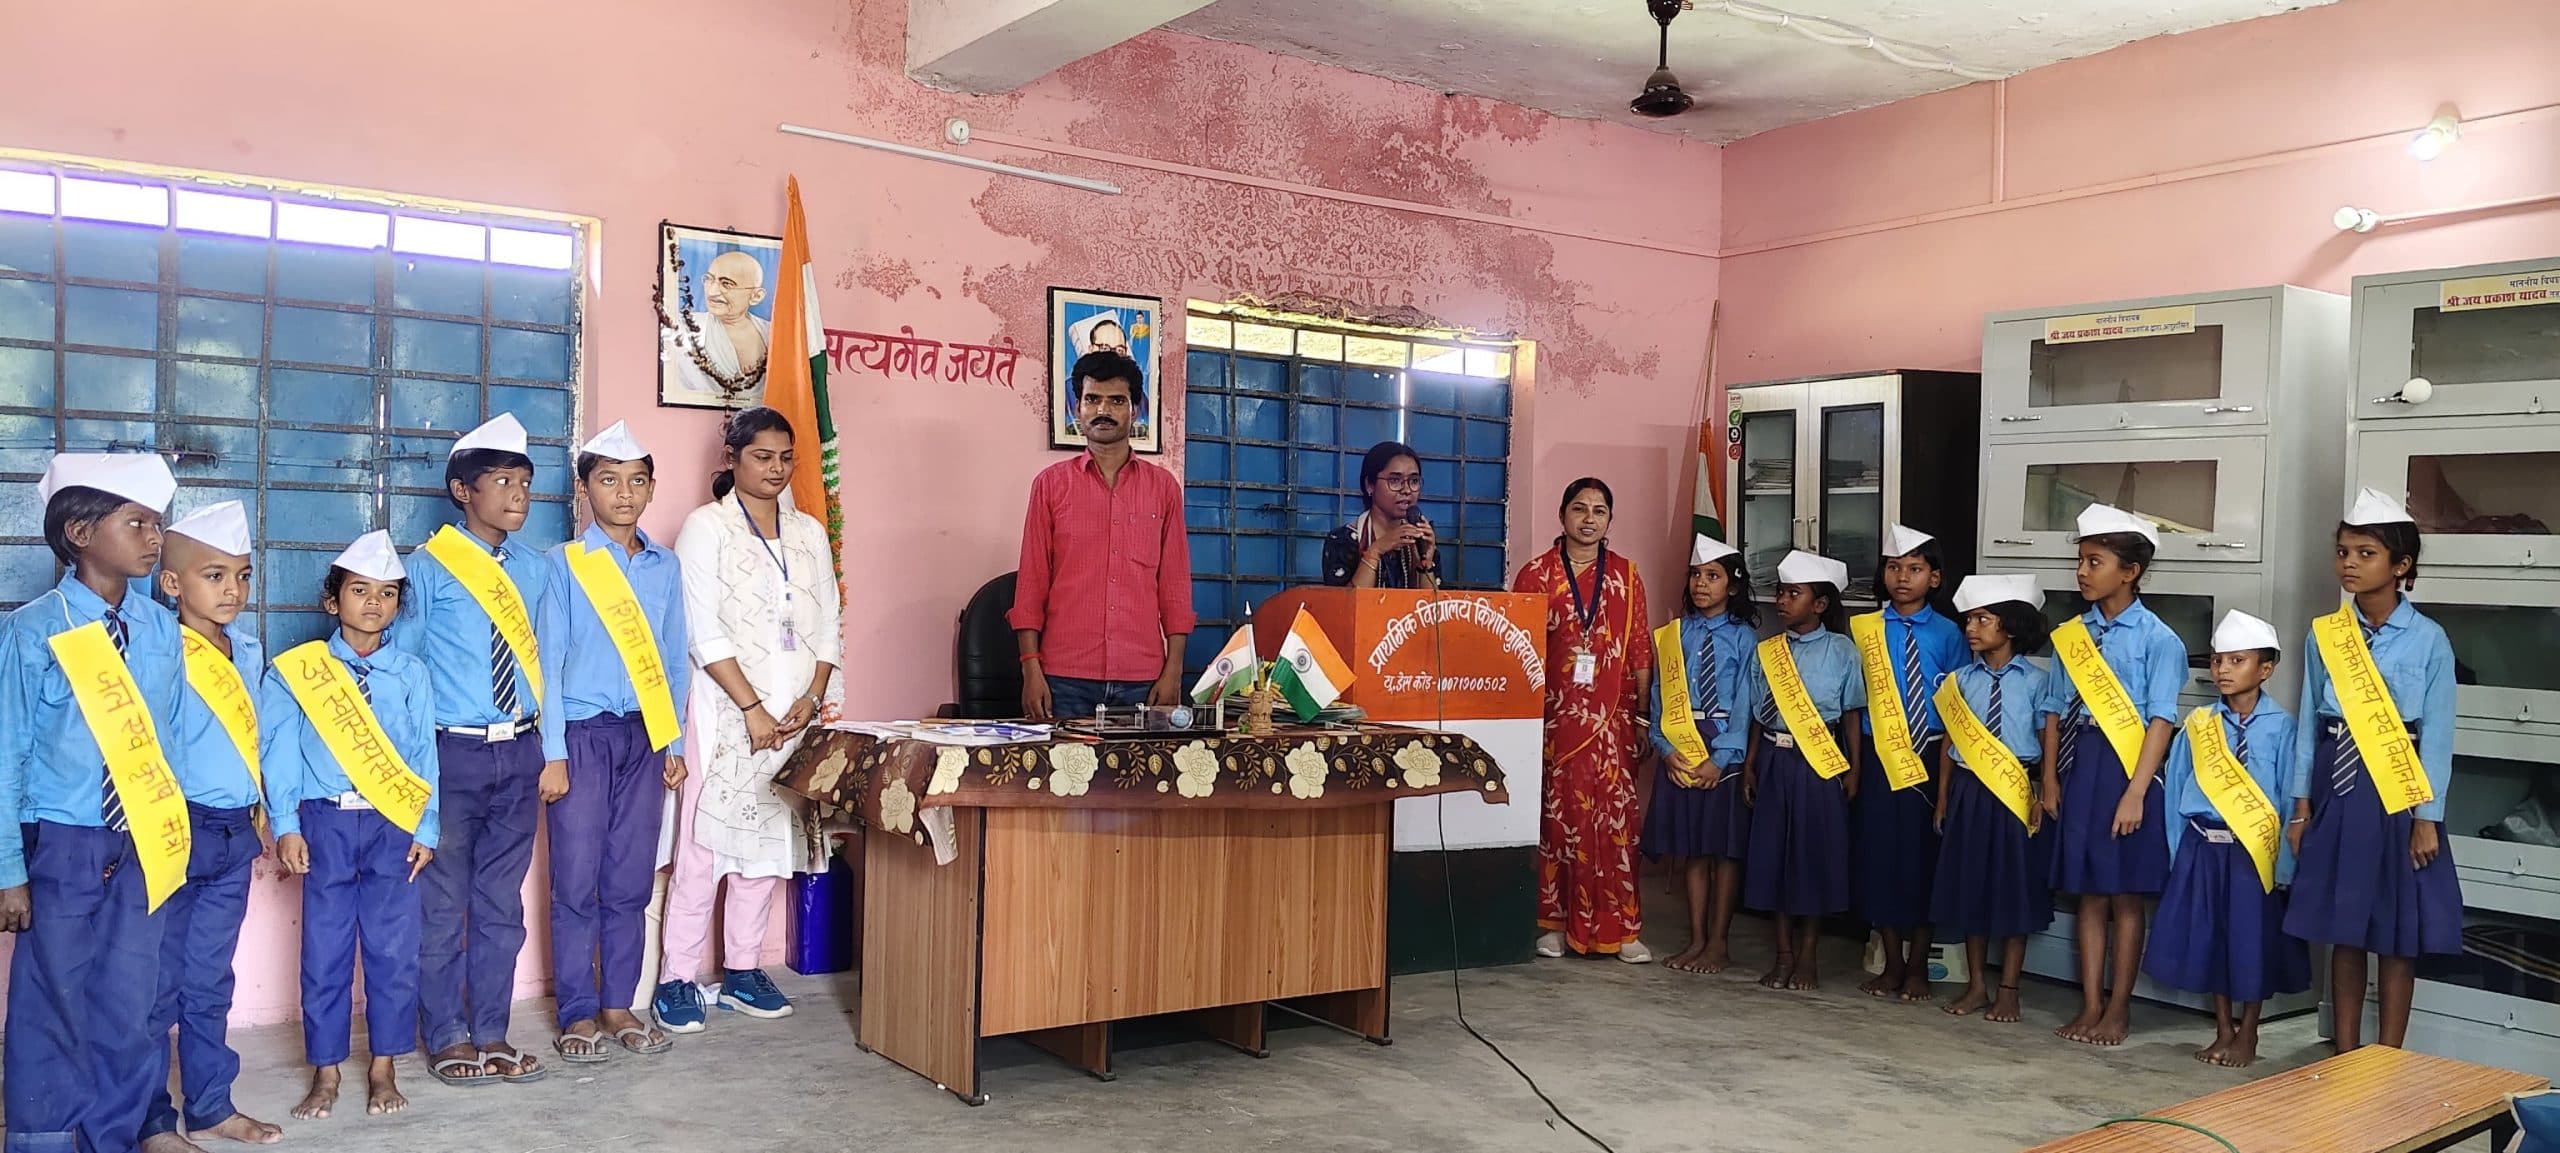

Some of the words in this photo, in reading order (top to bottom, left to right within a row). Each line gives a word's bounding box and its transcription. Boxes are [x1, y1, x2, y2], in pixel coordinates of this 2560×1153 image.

[2447, 295, 2460, 307] श्री
[2463, 295, 2481, 306] जय
[2484, 292, 2516, 304] प्रकाश
[2519, 289, 2547, 300] यादव
[945, 336, 1021, 390] जयते
[1368, 613, 1418, 675] प्राथमिक
[1415, 598, 1472, 629] विद्यालय
[95, 670, 135, 714] जल
[300, 657, 335, 691] उप
